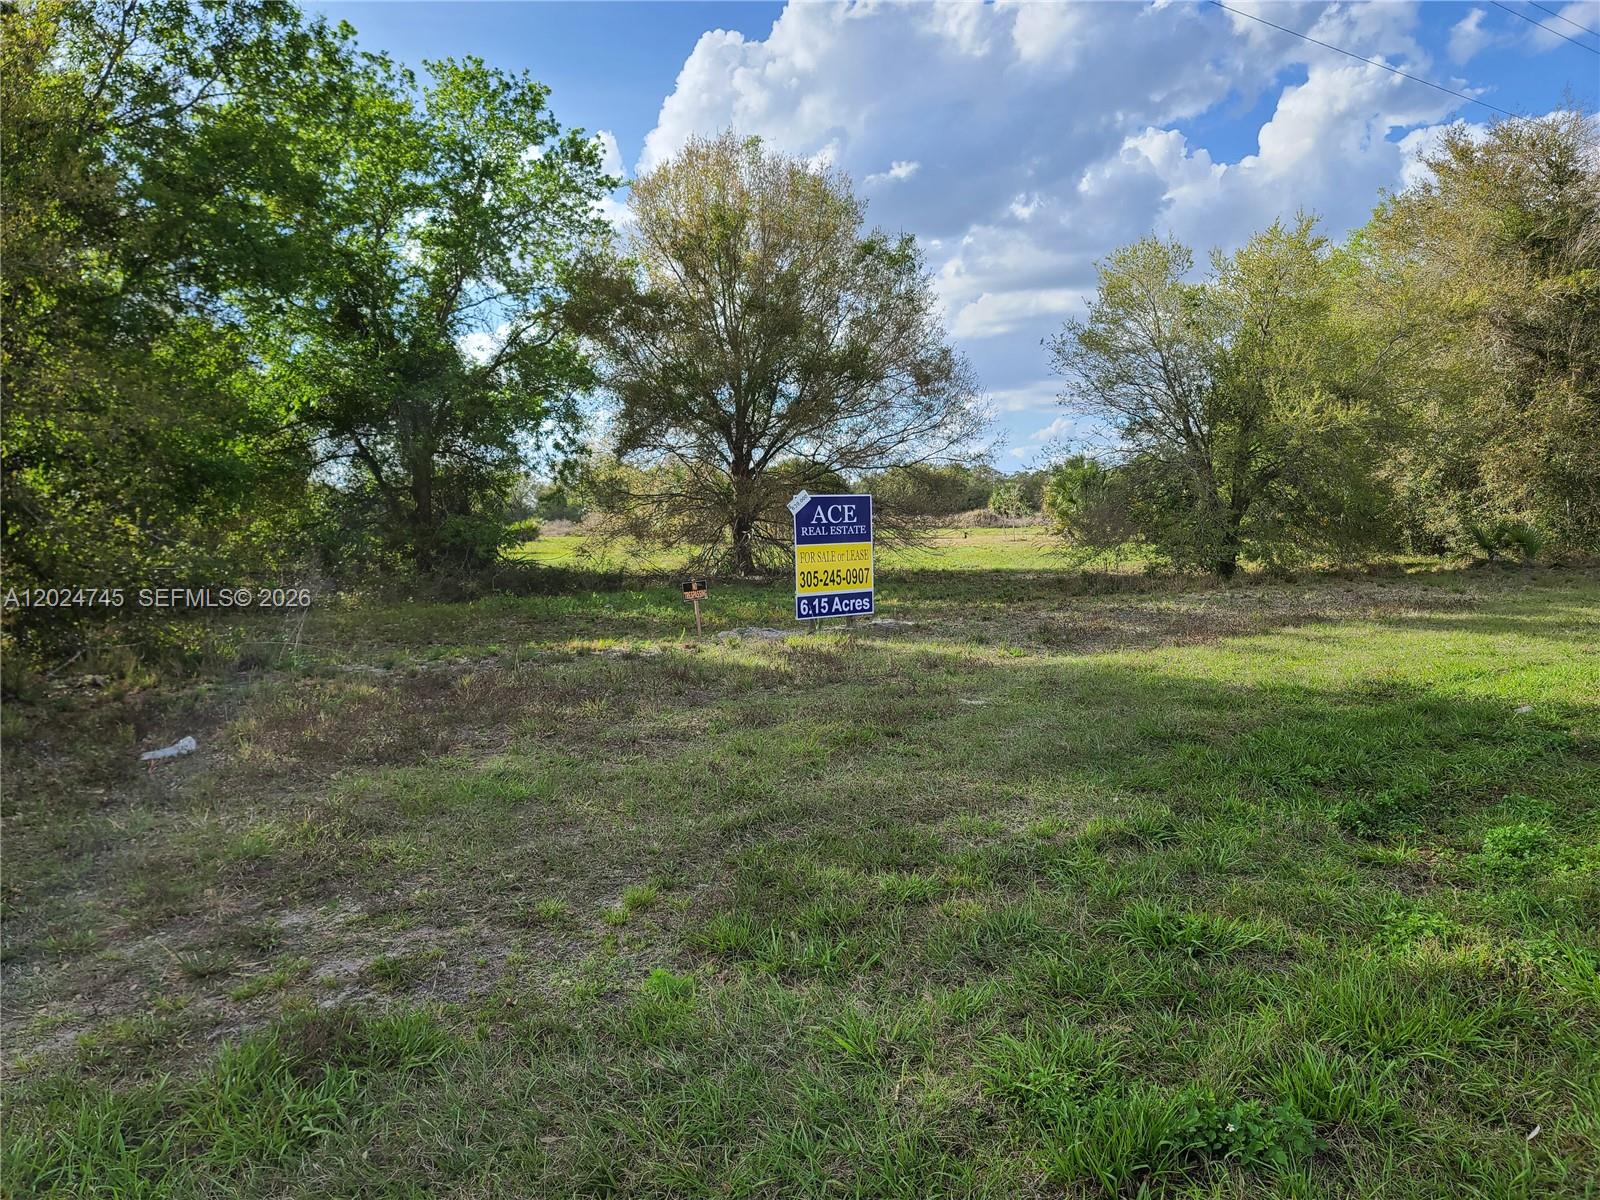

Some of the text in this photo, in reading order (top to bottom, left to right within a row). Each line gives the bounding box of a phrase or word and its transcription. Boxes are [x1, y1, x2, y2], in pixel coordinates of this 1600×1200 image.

[810, 504, 857, 524] ACE
[801, 525, 867, 536] REAL ESTATE
[800, 551, 816, 564] FOR
[816, 550, 836, 563] SALE
[846, 549, 869, 562] LEASE
[800, 567, 870, 589] 305-245-0907
[800, 596, 871, 616] 6.15 Acres
